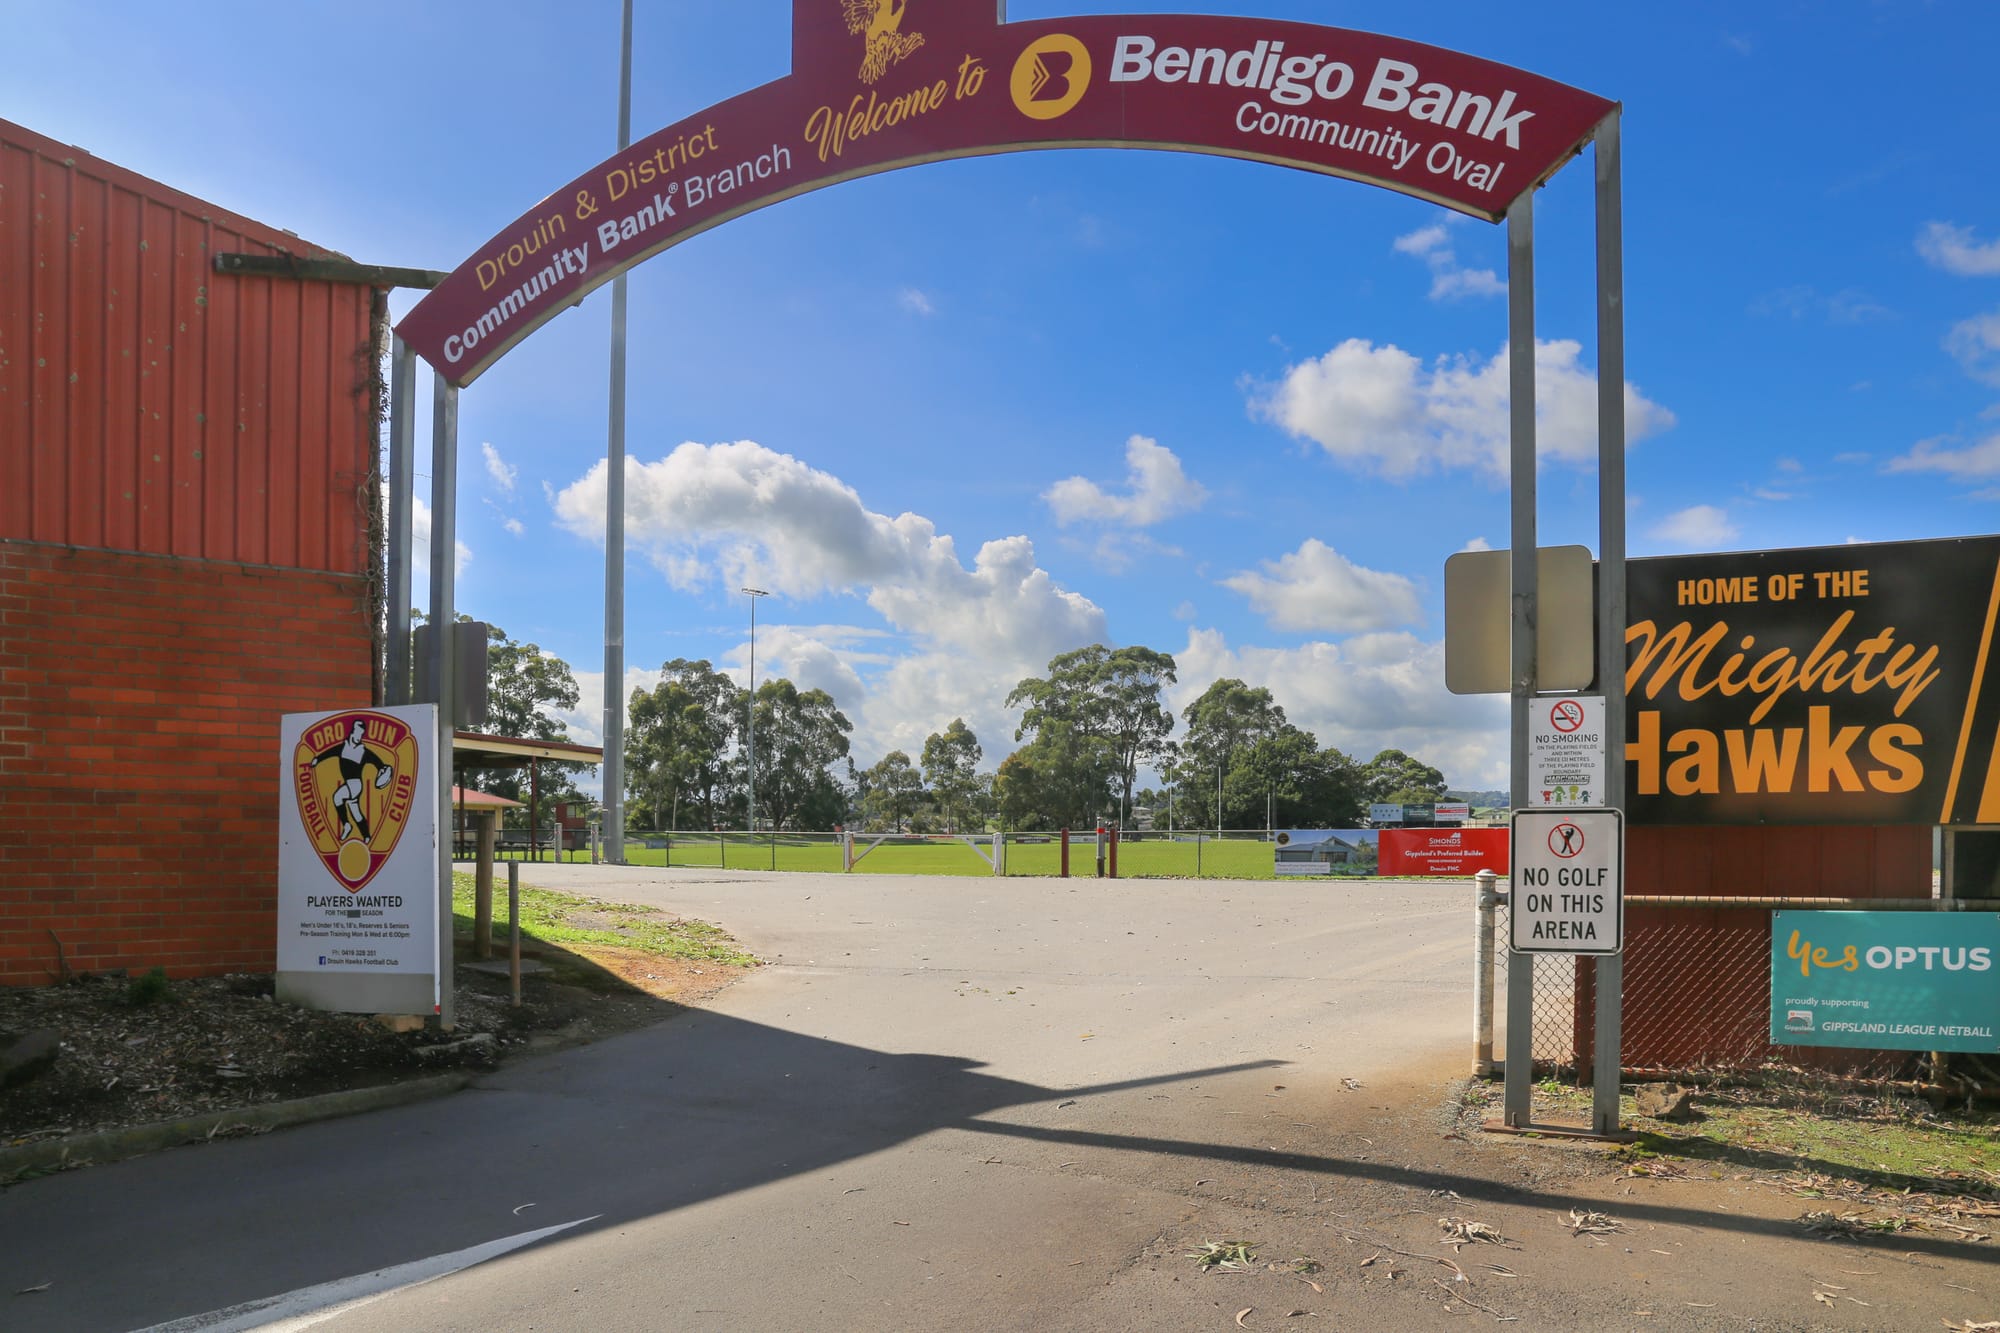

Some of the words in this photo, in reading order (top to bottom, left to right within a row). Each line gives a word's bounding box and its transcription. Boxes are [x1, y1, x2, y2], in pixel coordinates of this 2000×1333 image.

[804, 77, 948, 163] Welcome
[953, 53, 989, 102] to
[1109, 35, 1354, 105] Bendigo
[1361, 57, 1536, 151] Bank
[1234, 101, 1421, 170] Community
[1425, 141, 1505, 193] Oval
[475, 212, 566, 292] Drouin
[575, 190, 599, 220] &
[606, 124, 718, 203] District
[443, 242, 589, 365] Community
[684, 143, 792, 209] Branch
[1677, 576, 1758, 606] HOME
[1768, 573, 1804, 601] OF
[1813, 569, 1869, 598] THE
[1625, 609, 1941, 726] Mighty
[1535, 735, 1549, 743] NO
[1552, 734, 1598, 743] SMOKING
[299, 763, 326, 840] FOOTBALL
[388, 774, 411, 822] CLUB
[1524, 868, 1549, 886] NO
[1558, 868, 1608, 886] GOLF
[307, 896, 353, 907] PLAYERS
[356, 896, 402, 907] WANTED
[1527, 894, 1552, 912] ON
[1561, 894, 1604, 913] THIS
[1532, 921, 1597, 940] ARENA
[1865, 946, 1992, 971] OPTUS
[1785, 997, 1819, 1009] proudly
[1821, 998, 1869, 1009] supporting
[1822, 1021, 1886, 1034] GIPPSLAND
[1889, 1024, 1936, 1036] LEAGUE
[1938, 1026, 1993, 1037] NETBALL
